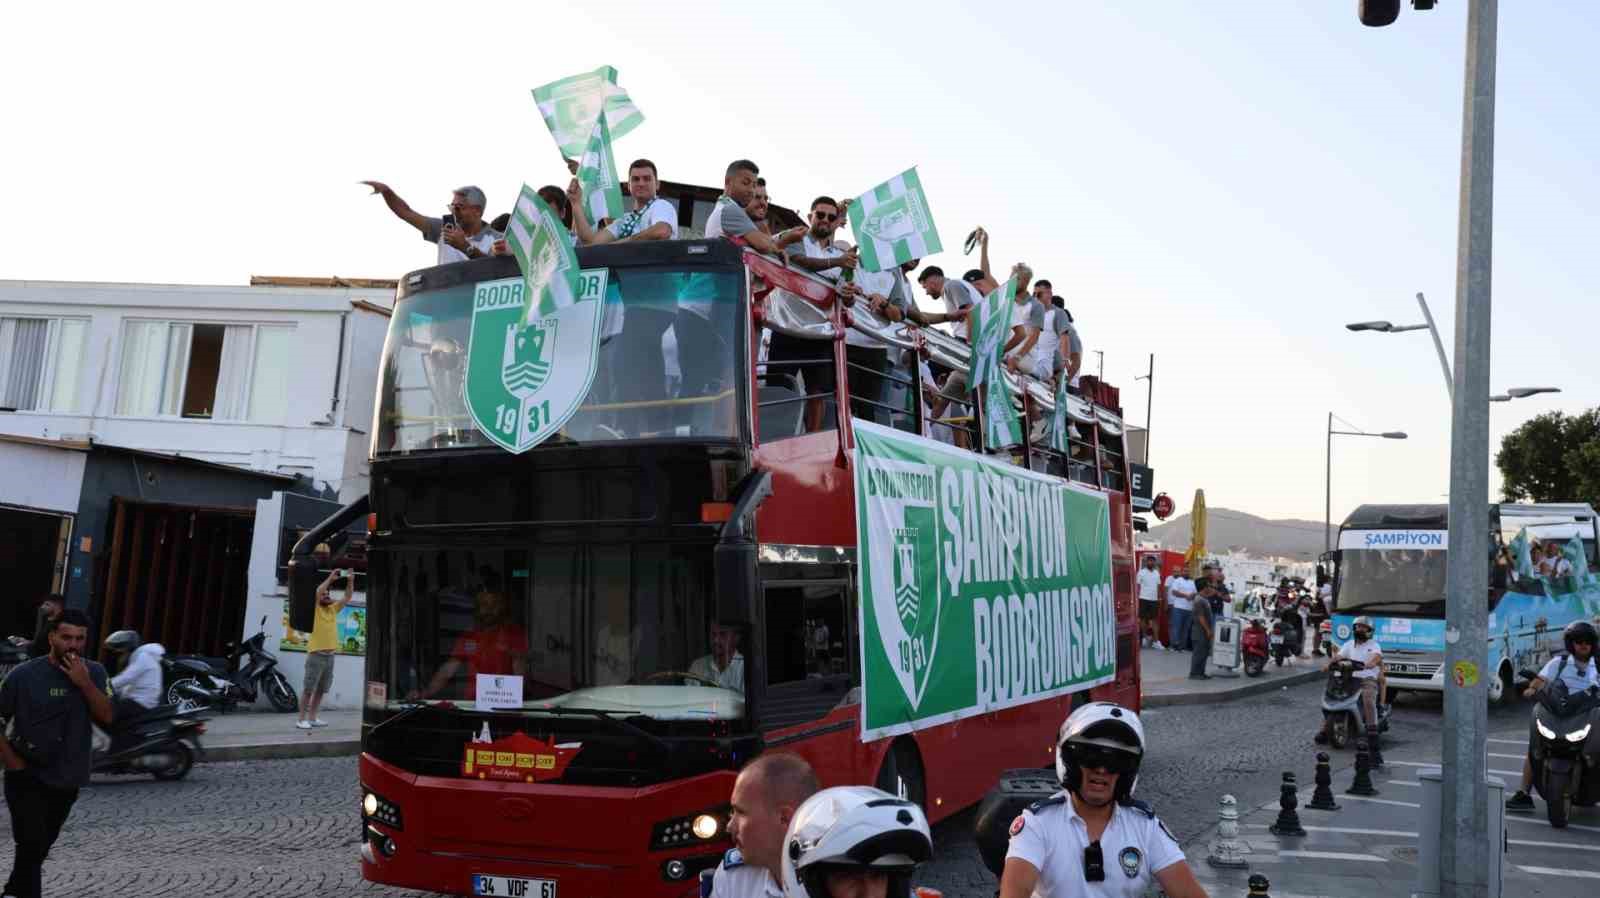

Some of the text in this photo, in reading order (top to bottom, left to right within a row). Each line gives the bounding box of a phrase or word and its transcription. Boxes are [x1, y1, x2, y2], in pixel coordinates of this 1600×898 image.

[476, 275, 600, 309] BODROR
[940, 466, 1068, 597] ŞAMPİYON
[1365, 531, 1442, 549] ŞAMPİYON
[973, 583, 1116, 706] BODRUMSPOR
[480, 877, 555, 898] 34 VDF 61
